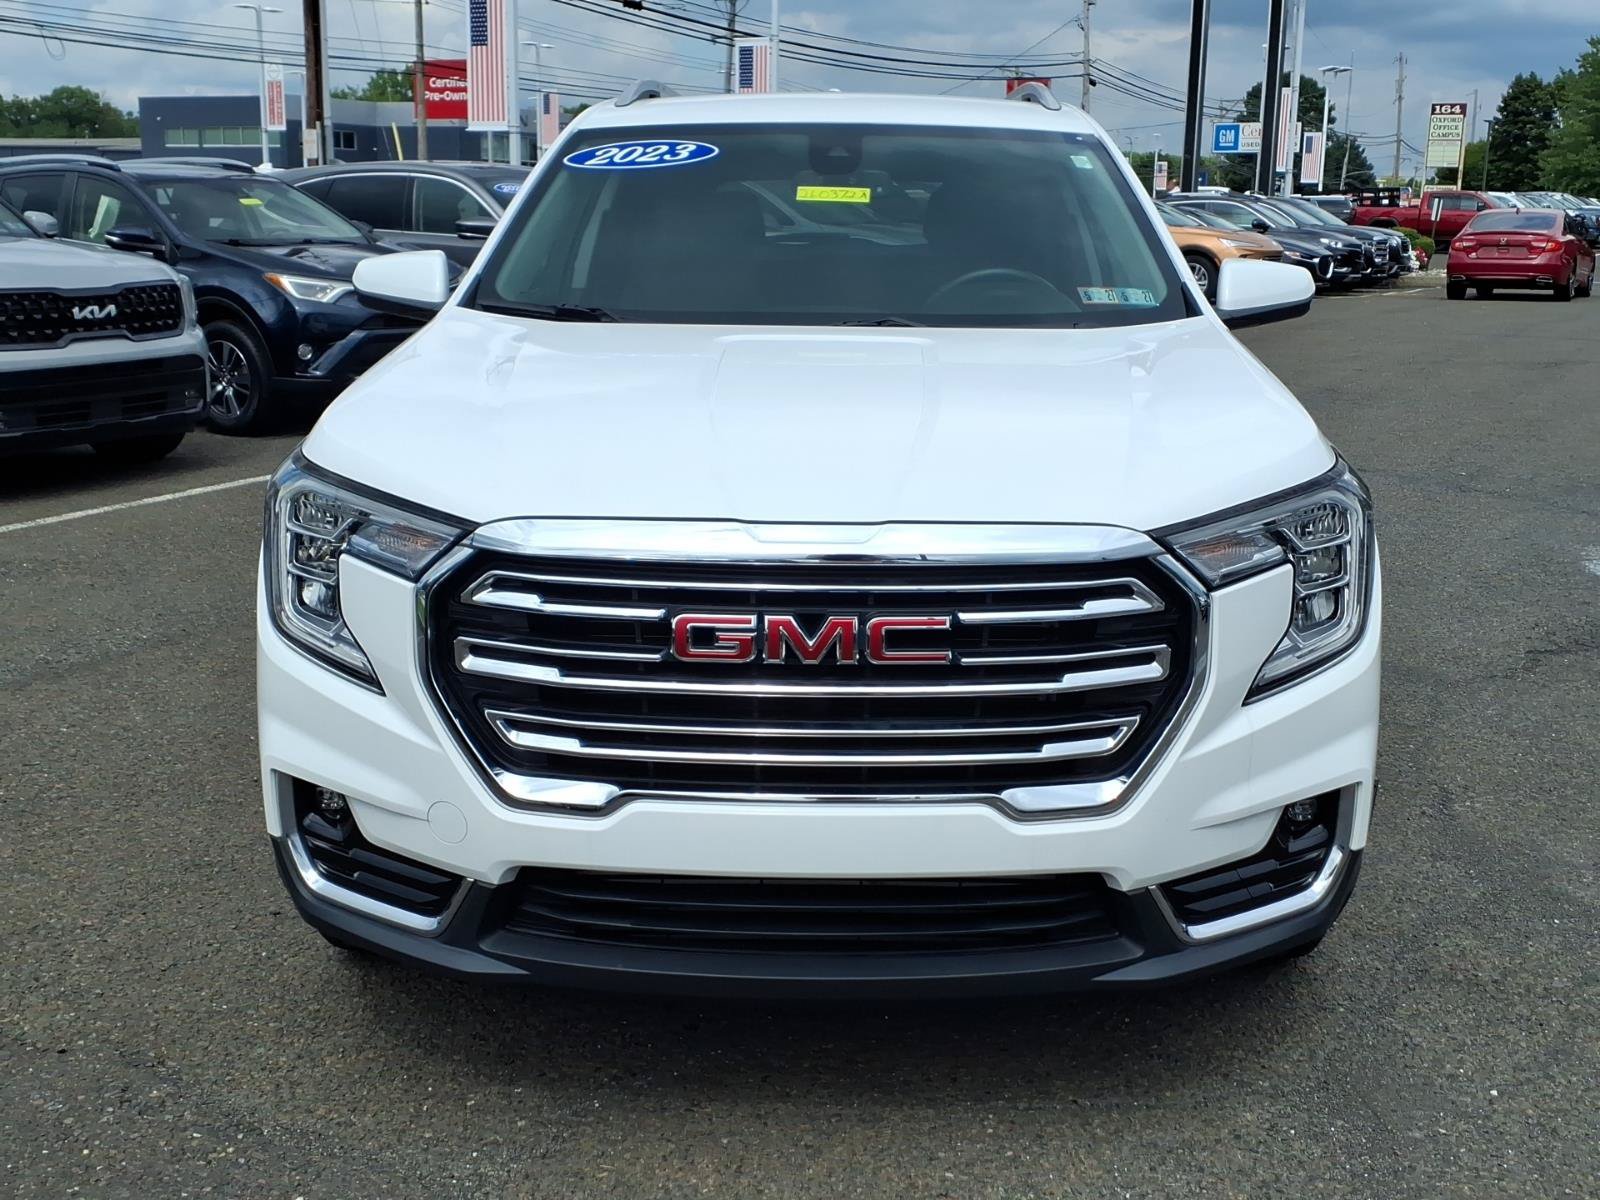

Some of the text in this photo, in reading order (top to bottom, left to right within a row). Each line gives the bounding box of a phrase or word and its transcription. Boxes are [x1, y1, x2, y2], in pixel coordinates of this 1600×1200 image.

[429, 76, 468, 88] Certifie
[424, 91, 468, 101] Pre-Own
[1433, 105, 1461, 114] 164
[1219, 129, 1235, 143] GM
[584, 144, 697, 165] 2023
[1141, 290, 1153, 303] 27
[72, 304, 117, 320] KIA
[670, 613, 952, 665] GMC
